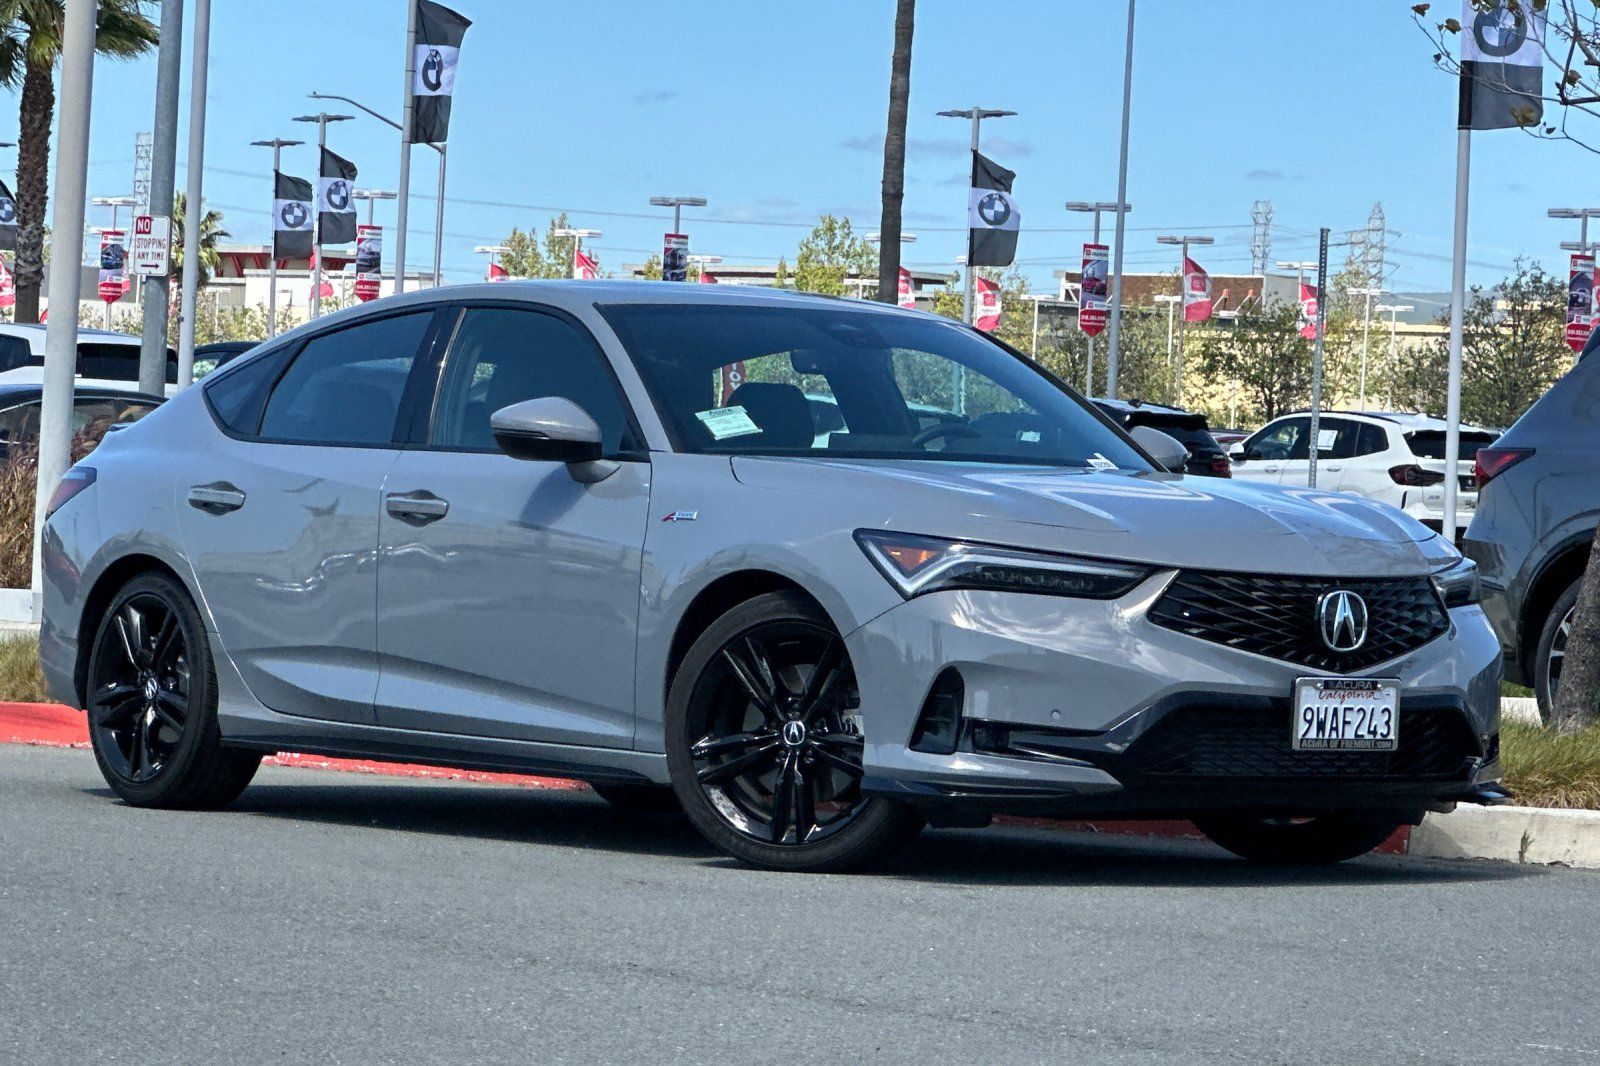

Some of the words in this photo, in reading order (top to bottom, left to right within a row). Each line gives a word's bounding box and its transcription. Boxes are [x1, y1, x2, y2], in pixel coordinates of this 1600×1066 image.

[137, 219, 150, 232] NO
[137, 238, 166, 249] STOPPING
[152, 252, 164, 260] TIME
[1336, 681, 1372, 689] ACURA
[1319, 690, 1375, 704] California
[1302, 707, 1391, 738] 9WAF243
[1302, 740, 1327, 748] ACURA
[1330, 740, 1339, 748] OF
